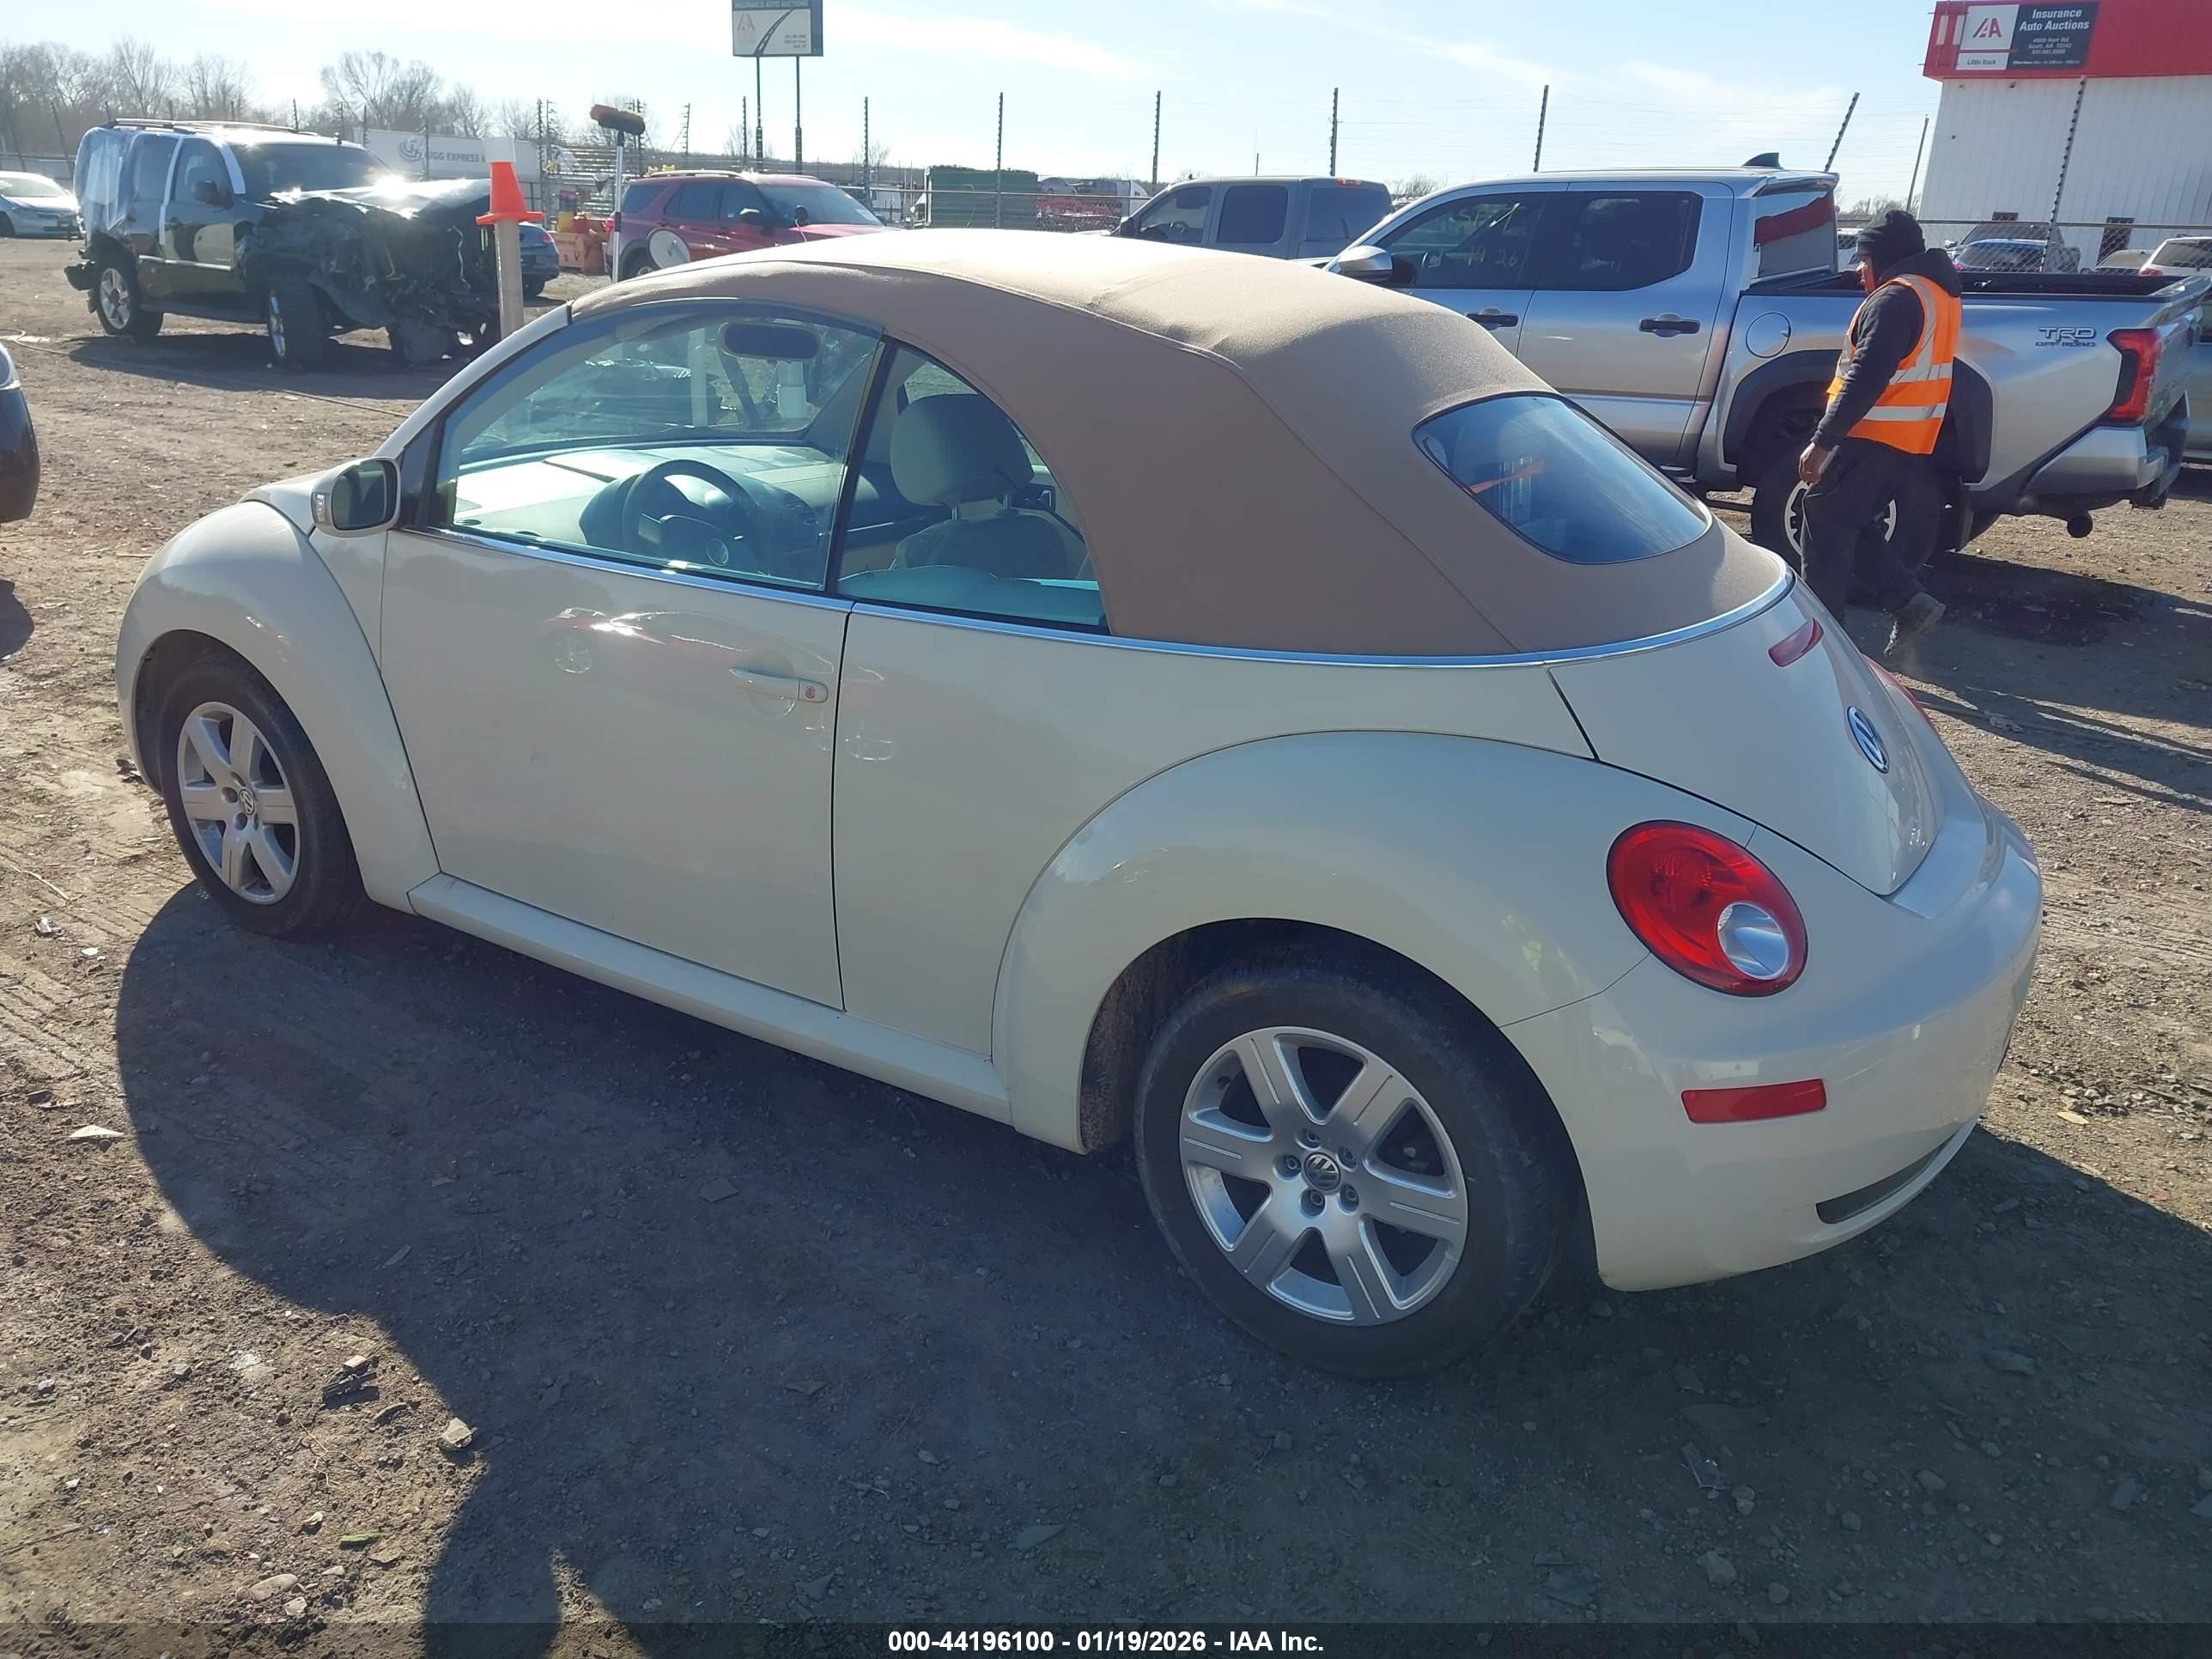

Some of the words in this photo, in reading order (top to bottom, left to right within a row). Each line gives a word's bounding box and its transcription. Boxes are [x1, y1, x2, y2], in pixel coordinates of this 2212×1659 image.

[2032, 9, 2082, 19] Insurance
[2019, 21, 2043, 32] Auto
[2044, 19, 2090, 31] Auctions
[2039, 326, 2097, 342] TRD
